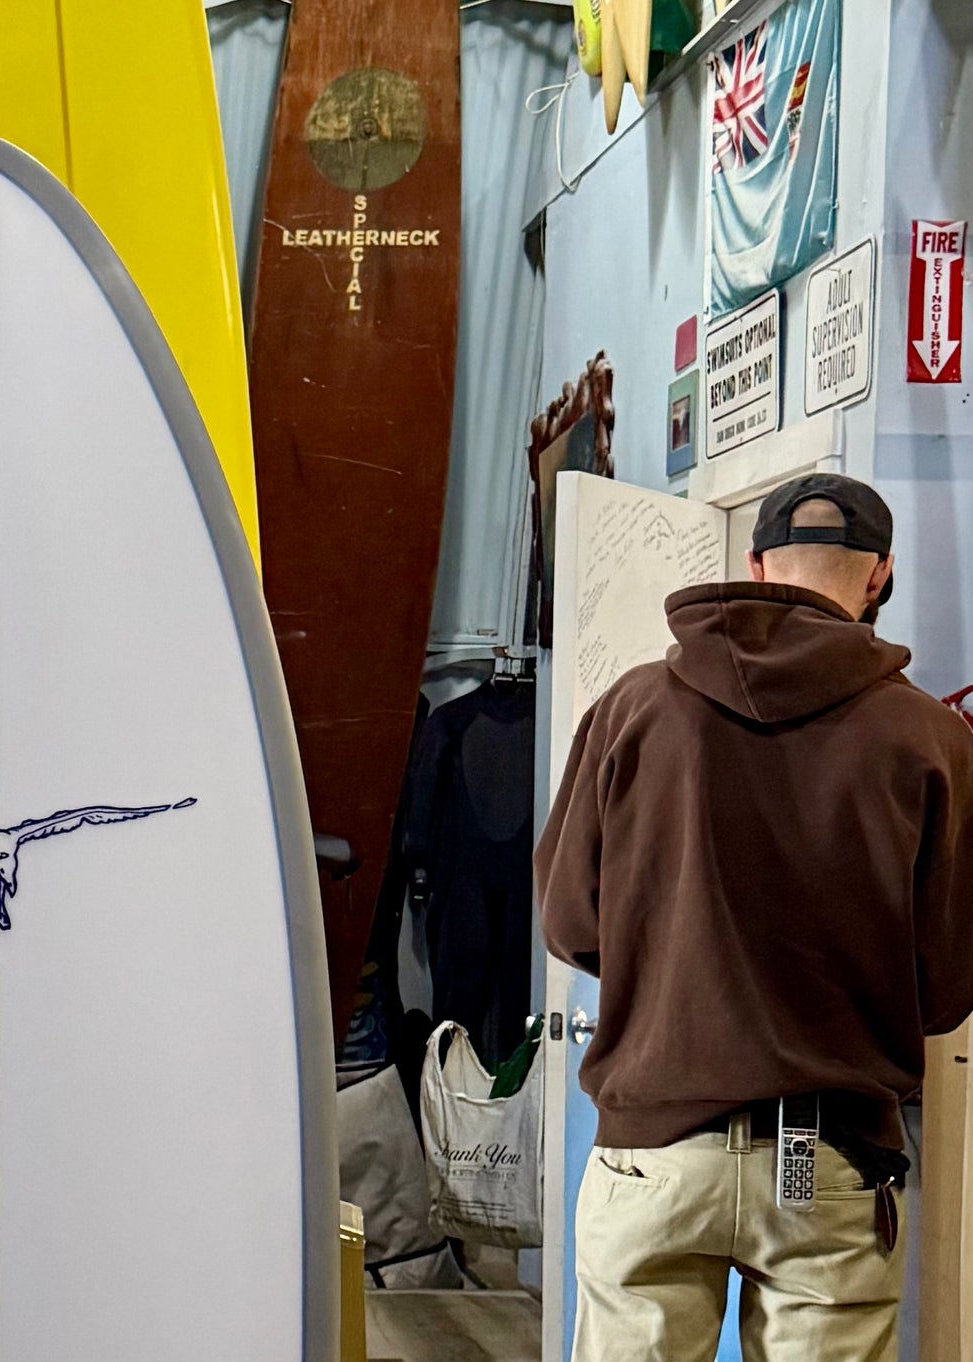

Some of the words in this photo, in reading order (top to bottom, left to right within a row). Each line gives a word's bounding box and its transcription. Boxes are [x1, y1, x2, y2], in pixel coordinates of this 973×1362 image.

[282, 230, 440, 246] LEATHERNECK
[347, 195, 367, 311] SPECIAL
[921, 231, 959, 253] FIRE
[827, 269, 852, 315] ADULT
[930, 258, 943, 368] EXTINGUISHER
[707, 333, 743, 375] SWIMSUITS
[745, 313, 776, 354] OPTIONAL
[812, 302, 864, 359] SUPERVISION
[711, 374, 736, 409] BEYOND
[738, 365, 752, 396] THIS
[754, 353, 773, 388] POINT
[817, 344, 856, 393] REQUIRED
[484, 1143, 522, 1170] You
